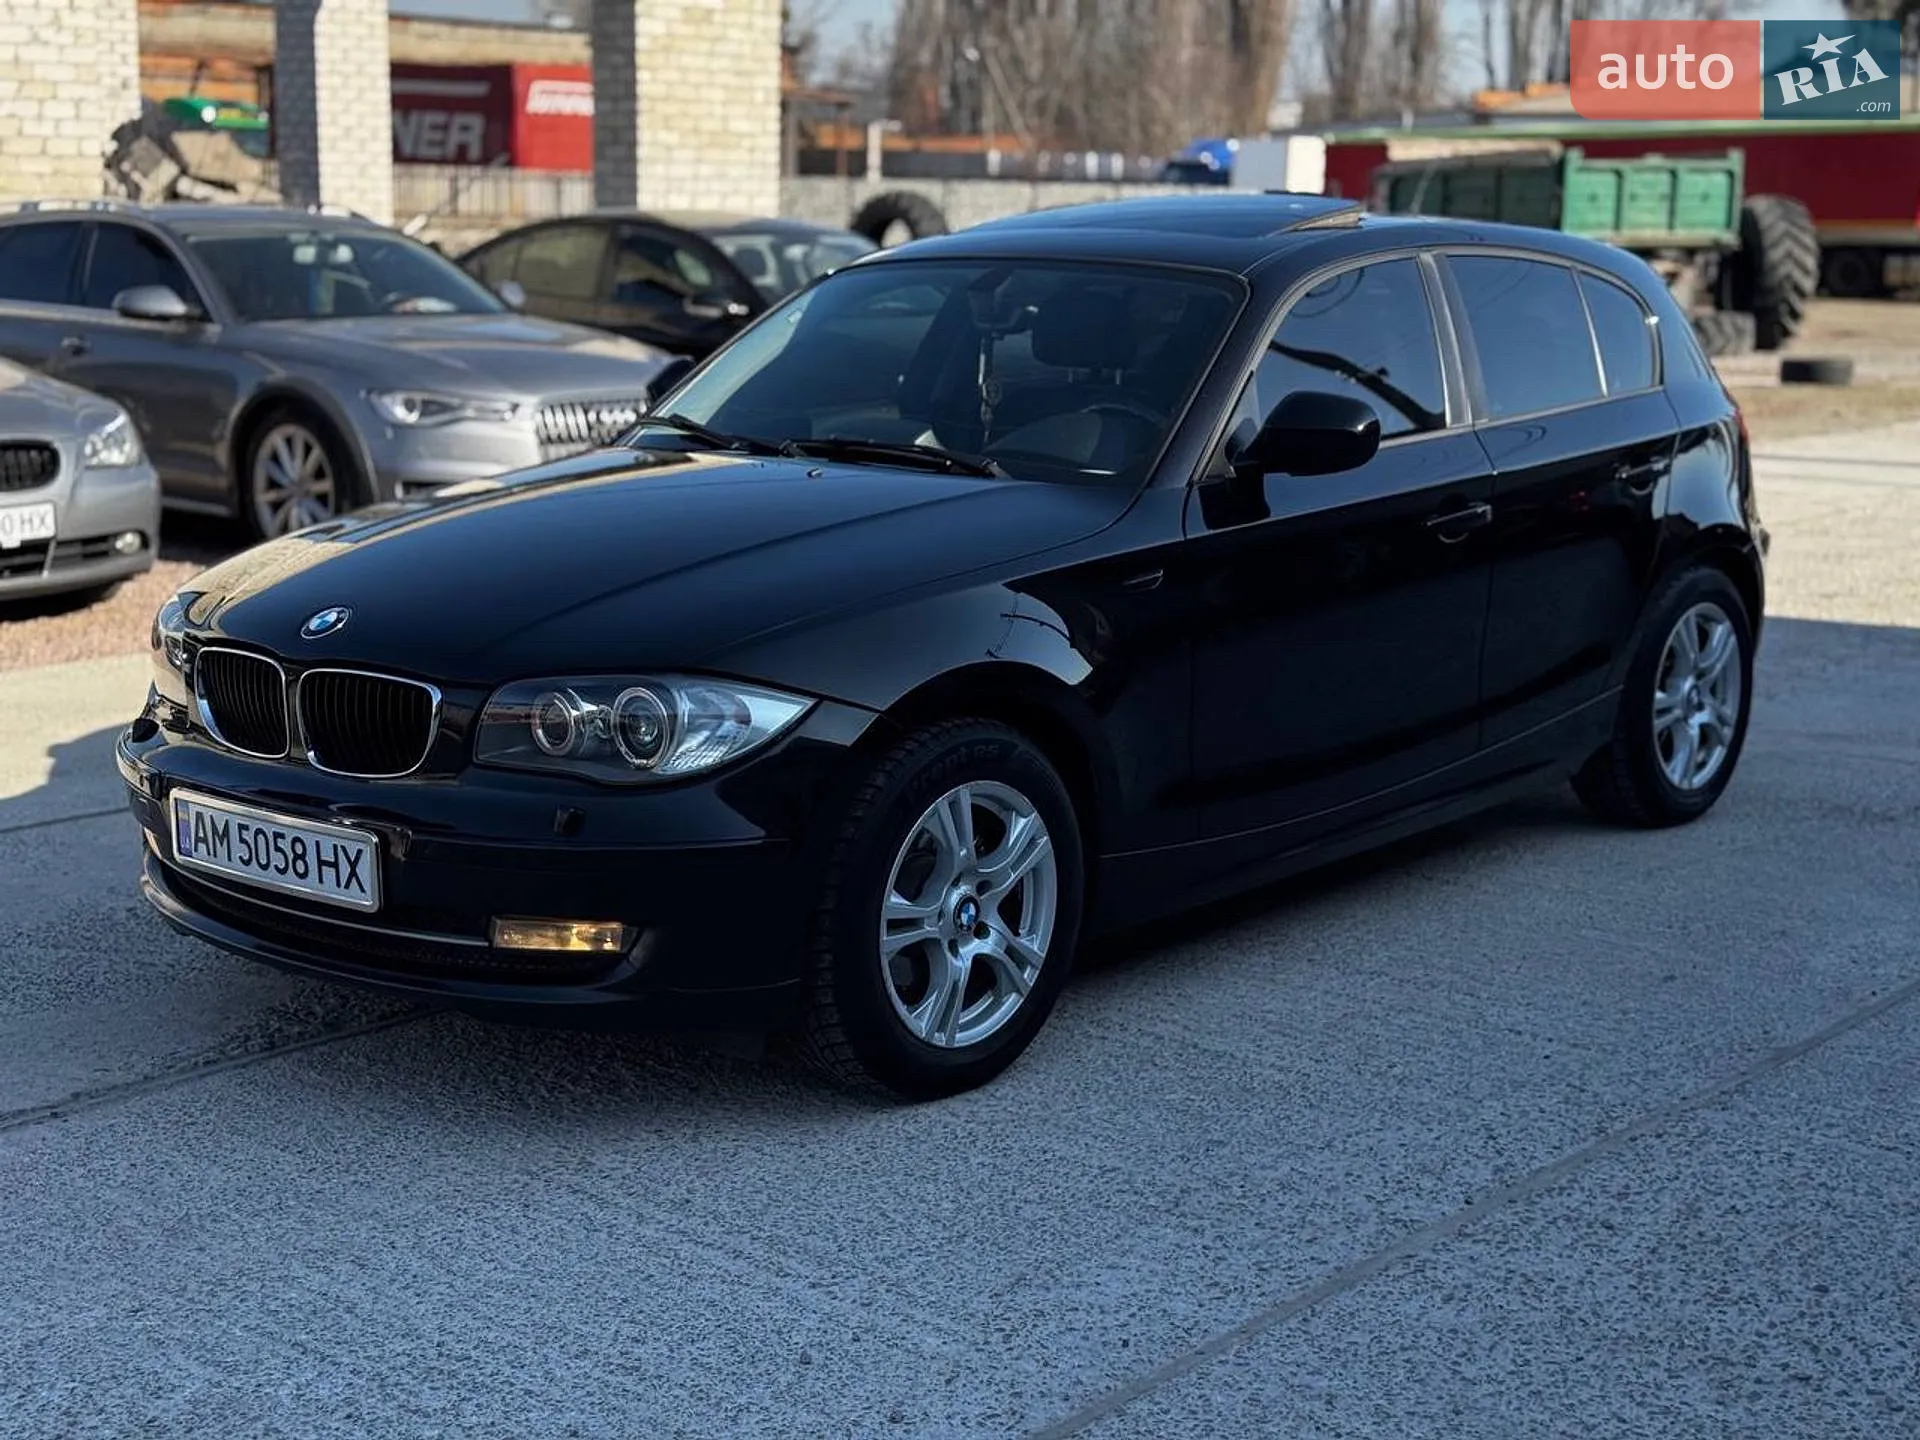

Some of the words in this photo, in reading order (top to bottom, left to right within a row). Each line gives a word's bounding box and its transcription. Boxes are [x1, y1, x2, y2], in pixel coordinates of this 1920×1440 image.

[20, 510, 50, 533] HX
[193, 811, 232, 862] AM
[237, 822, 310, 880] 5058
[314, 839, 367, 894] HX
